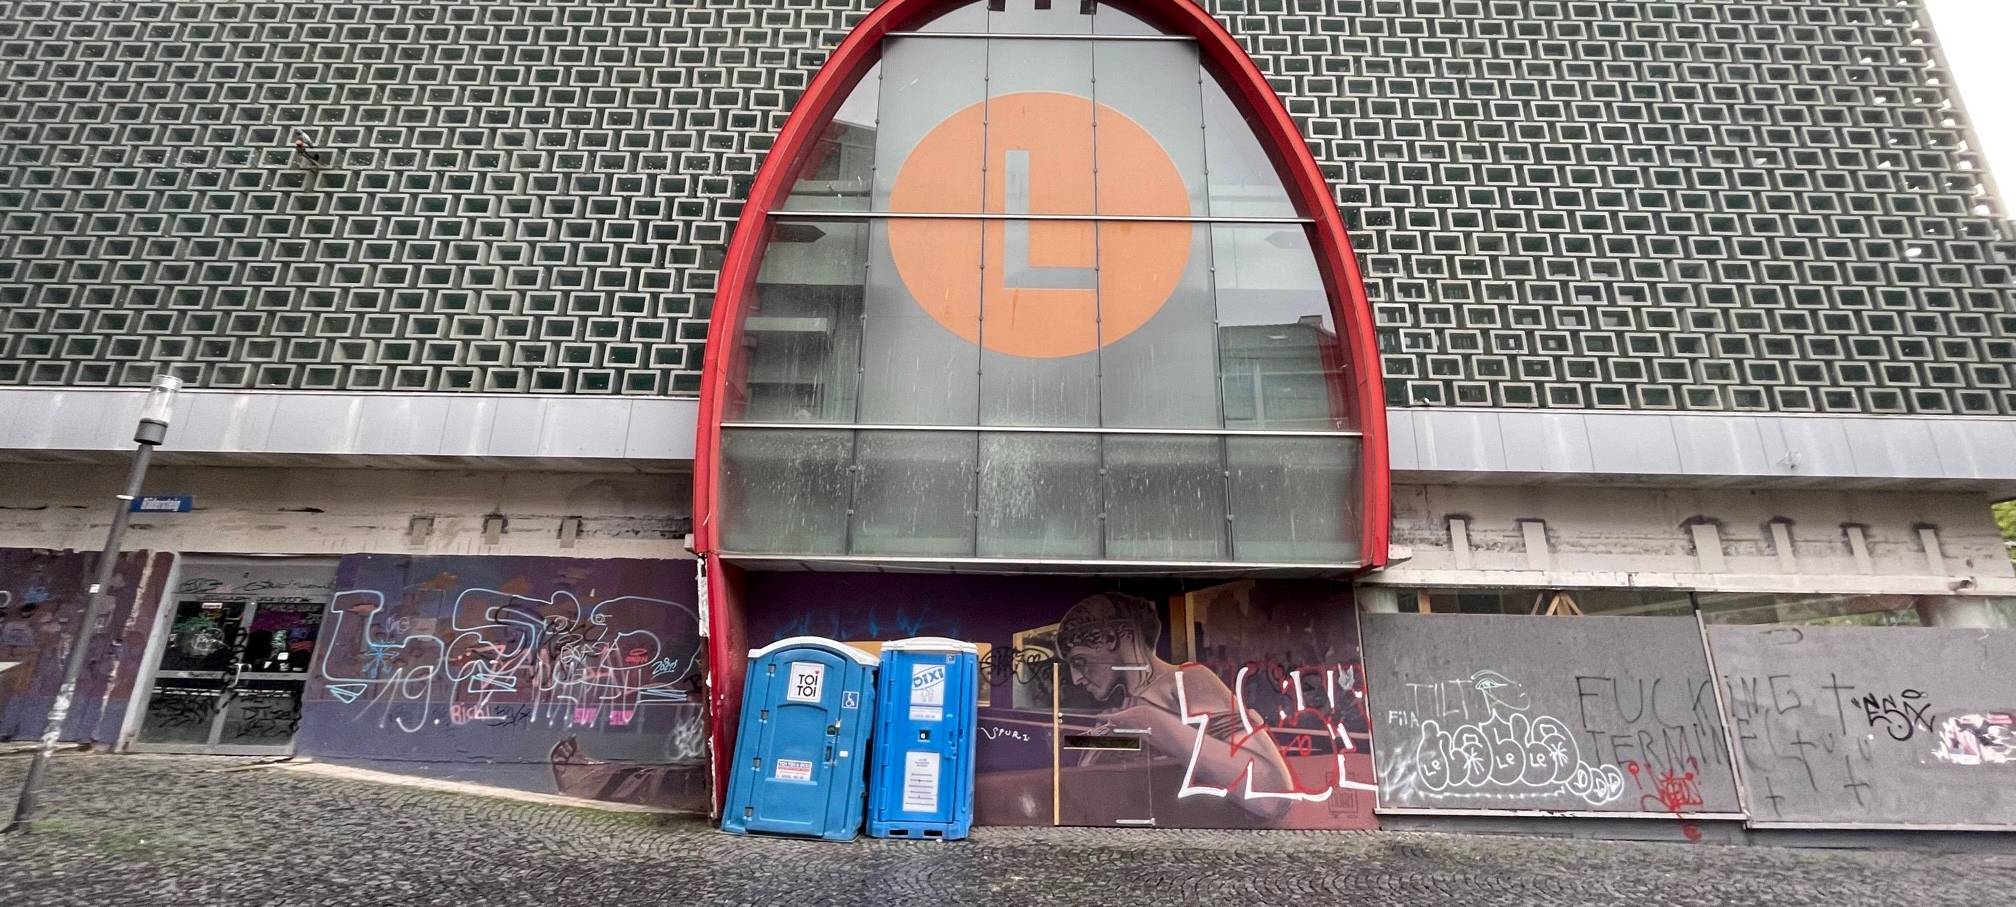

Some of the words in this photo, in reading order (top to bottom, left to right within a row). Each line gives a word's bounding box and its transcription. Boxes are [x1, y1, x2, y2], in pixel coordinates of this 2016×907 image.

[1004, 150, 1097, 289] L
[798, 673, 818, 686] TOI
[913, 668, 944, 688] DIXI
[796, 685, 817, 698] TOI
